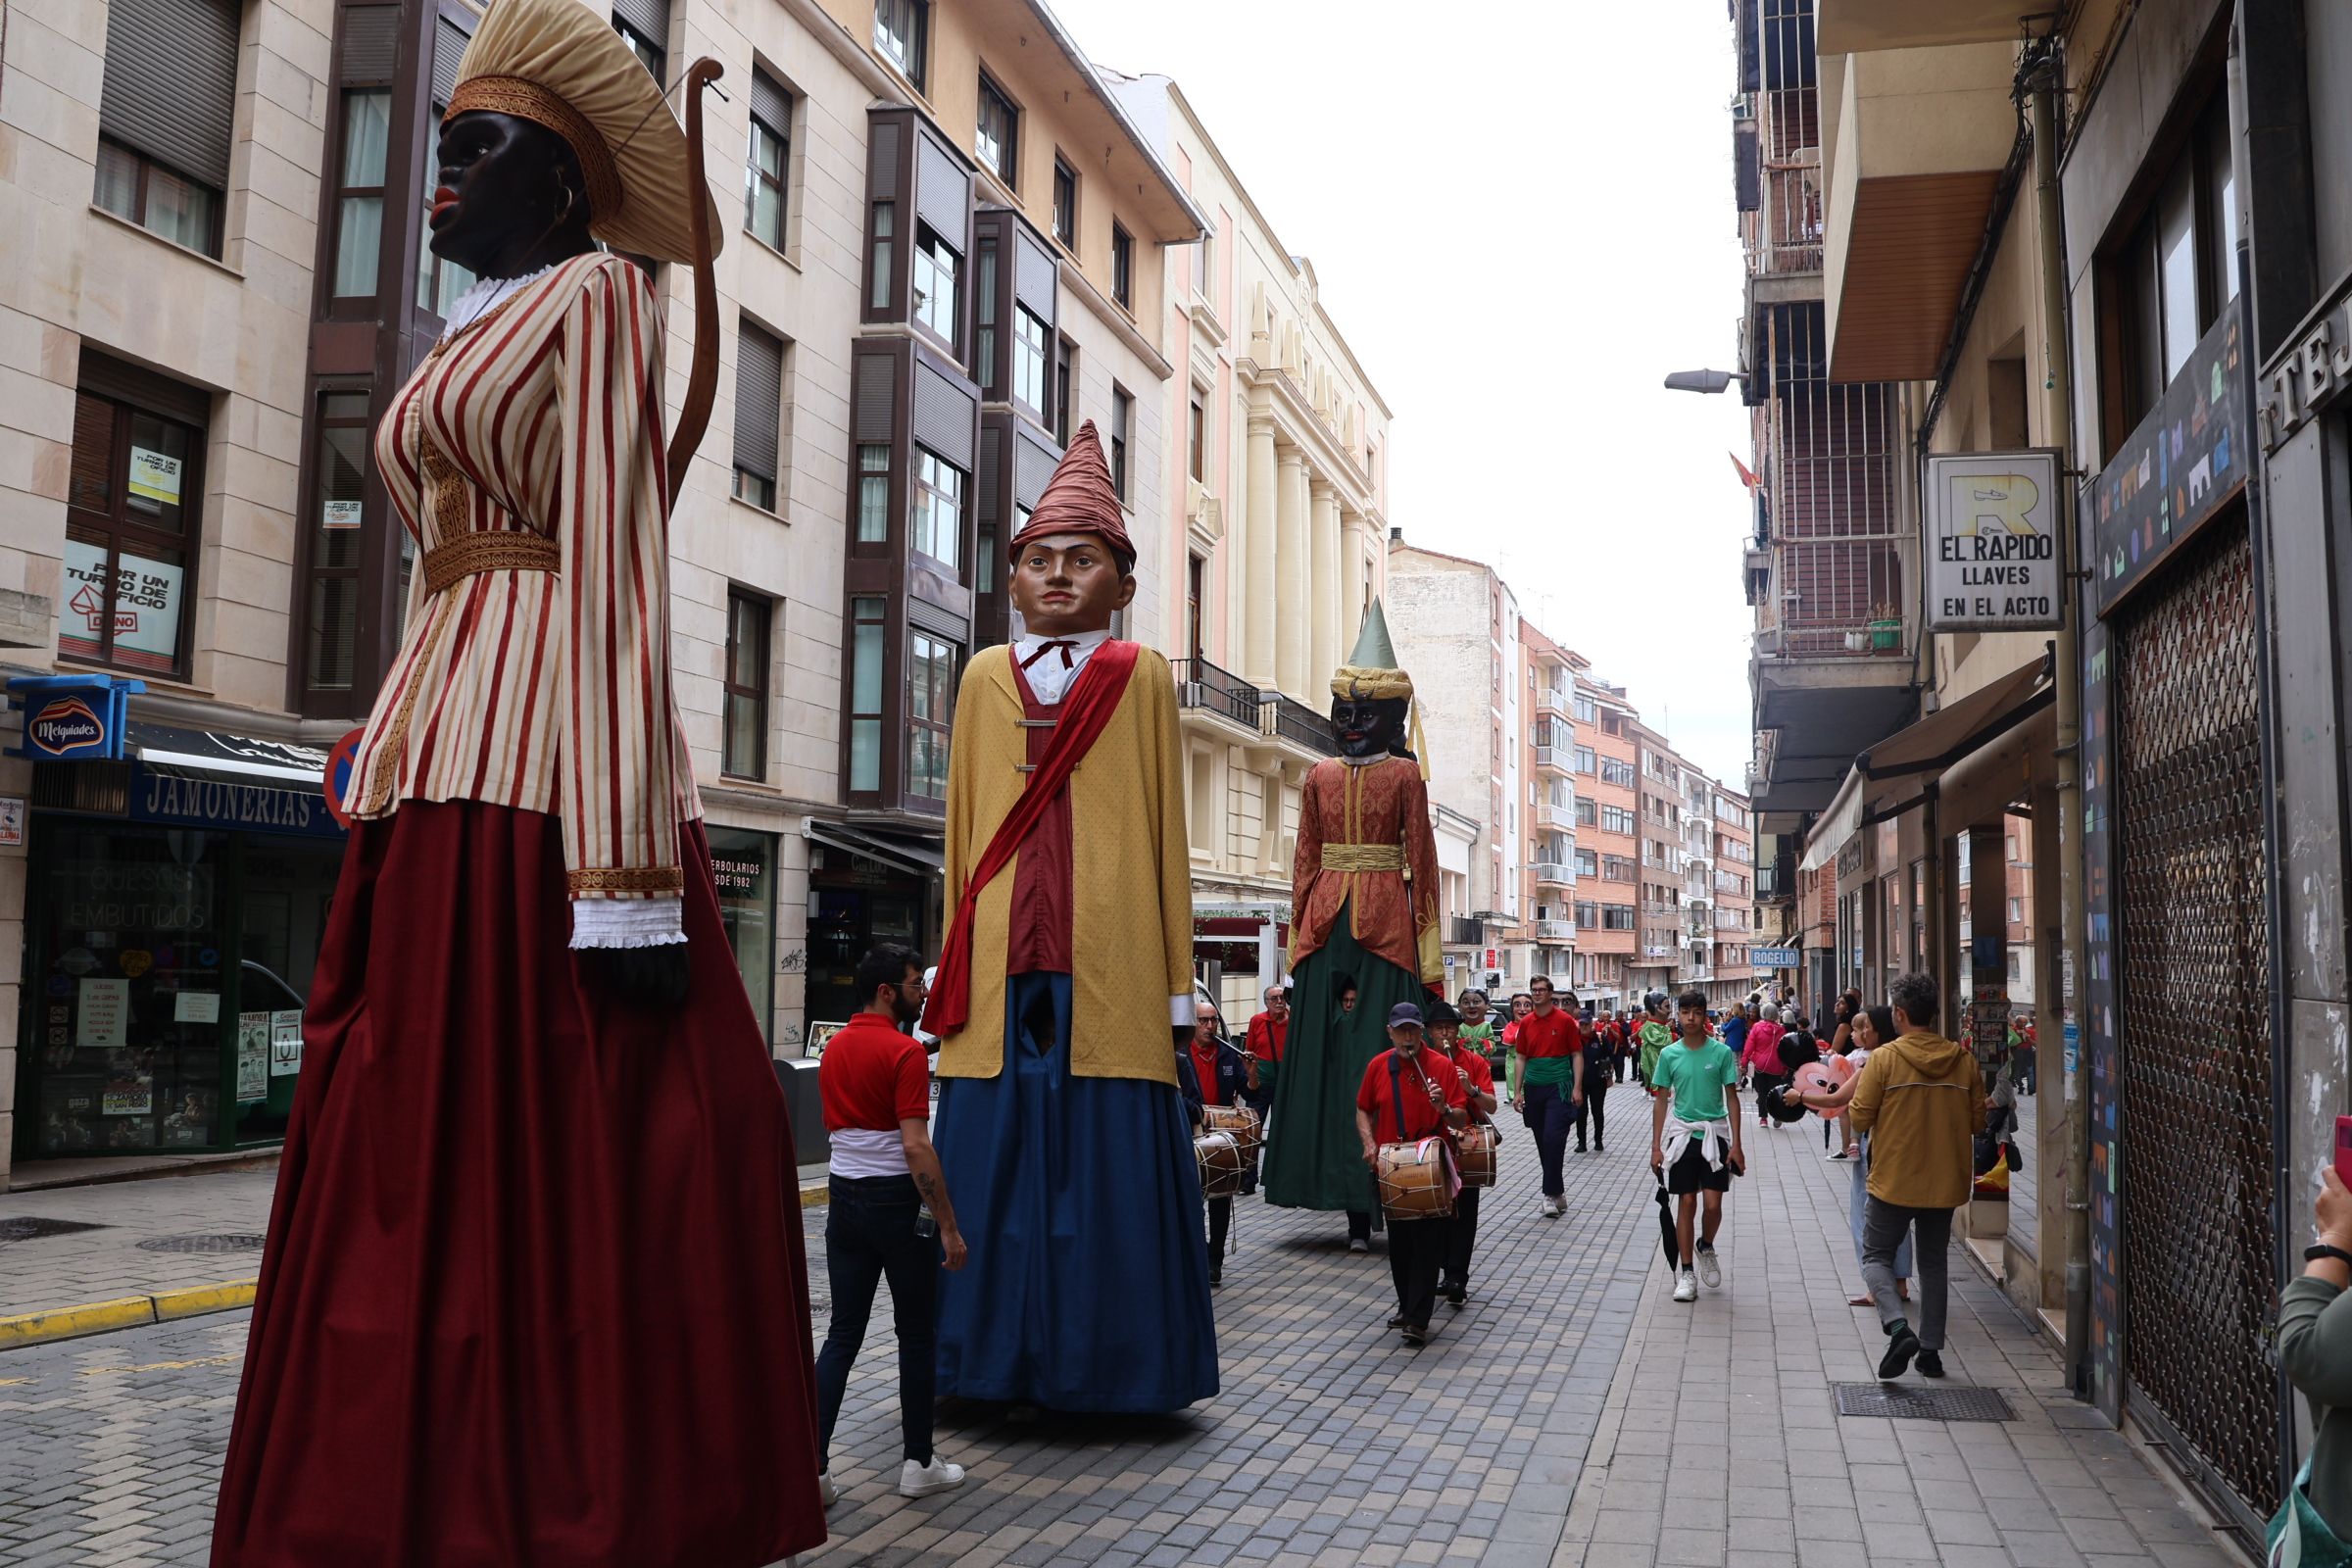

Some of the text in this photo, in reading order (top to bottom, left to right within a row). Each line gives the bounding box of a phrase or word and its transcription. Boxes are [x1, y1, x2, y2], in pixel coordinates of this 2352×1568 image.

[136, 456, 164, 466] TURNO
[150, 465, 175, 475] OFICIO
[1941, 534, 2052, 562] EL RAPIDO
[67, 567, 168, 600] TURO DE
[93, 563, 170, 589] PR UN
[1962, 565, 2031, 586] LLAVES
[1943, 596, 2049, 616] EN EL ACTO
[93, 615, 134, 627] DNO
[38, 721, 95, 743] Melquiades
[147, 776, 311, 828] JAMONERIAS
[733, 876, 750, 888] 1982
[1753, 952, 1795, 965] ROGELIO
[932, 1084, 940, 1096] 3
